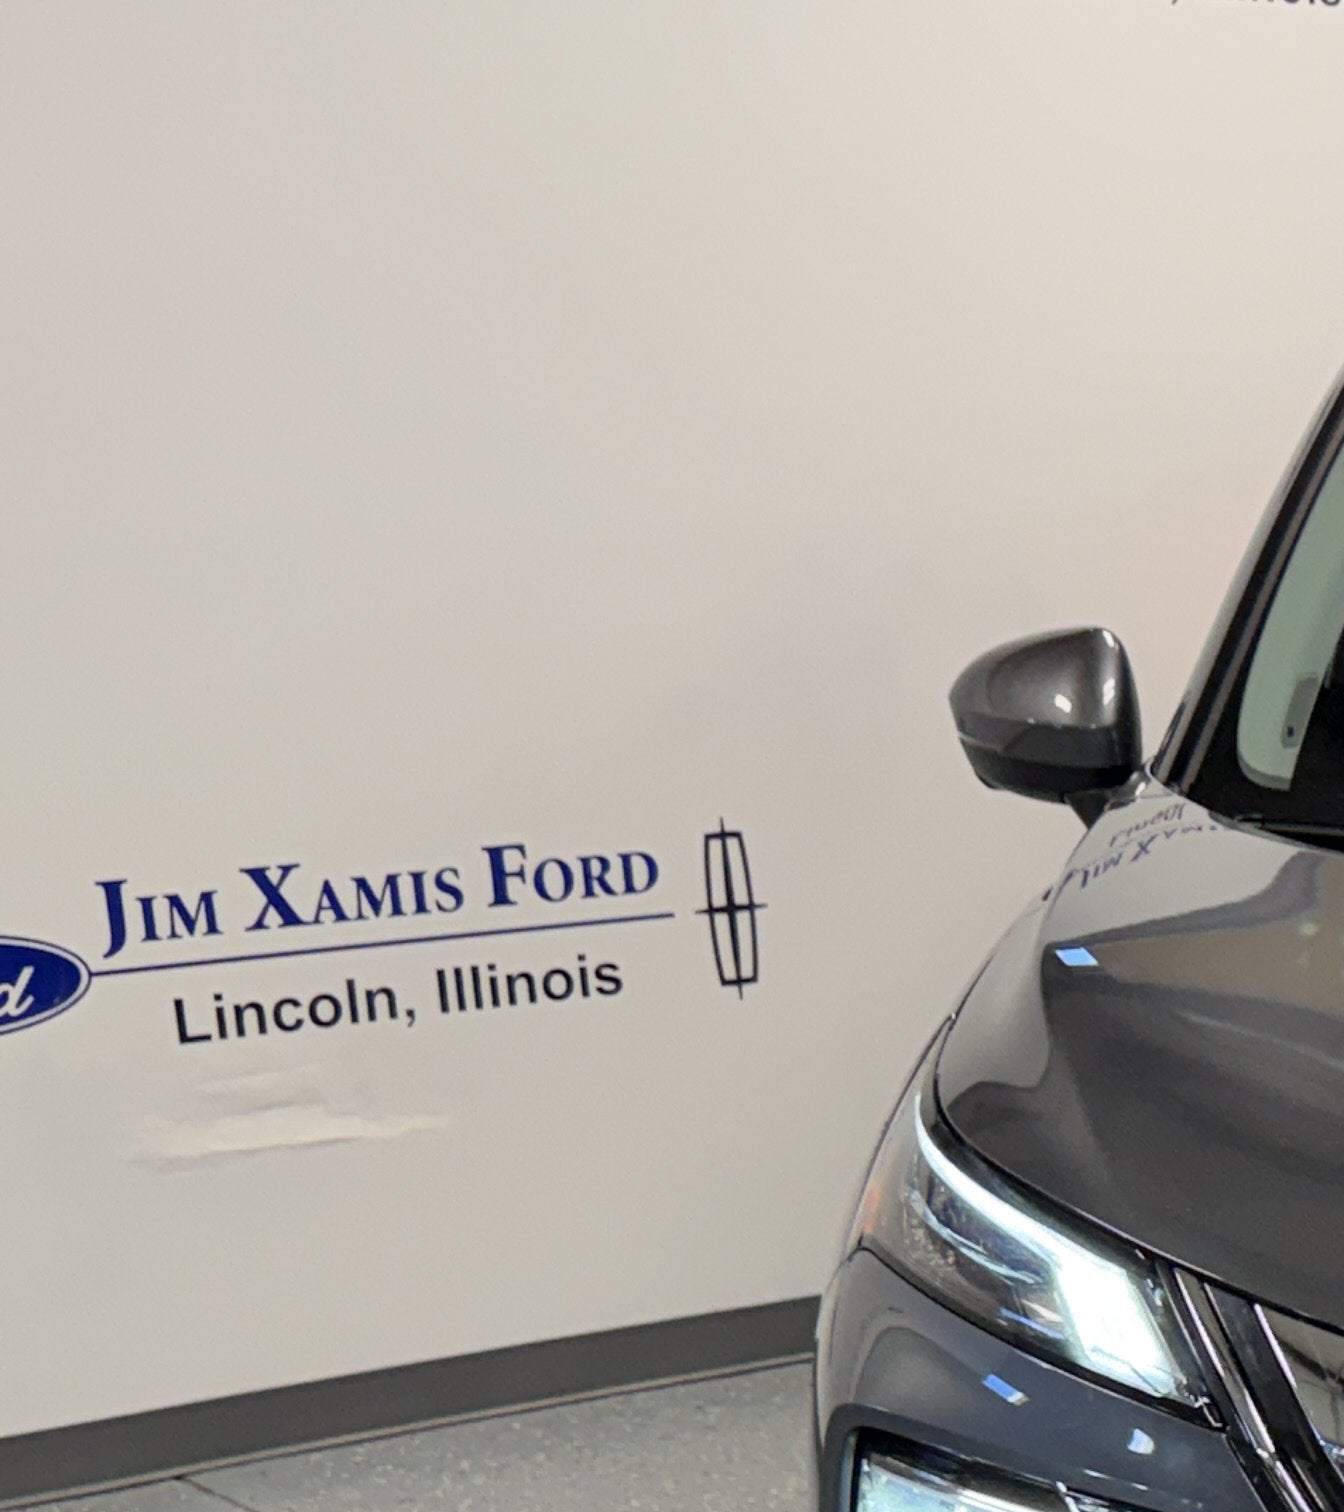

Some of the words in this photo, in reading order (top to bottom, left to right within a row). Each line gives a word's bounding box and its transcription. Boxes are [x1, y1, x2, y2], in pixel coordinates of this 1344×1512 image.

[95, 879, 223, 957] JIM
[239, 863, 465, 932] XAMIS
[481, 844, 660, 907] FORD
[172, 978, 417, 1045] Lincoln,
[436, 954, 624, 1016] Illinois
